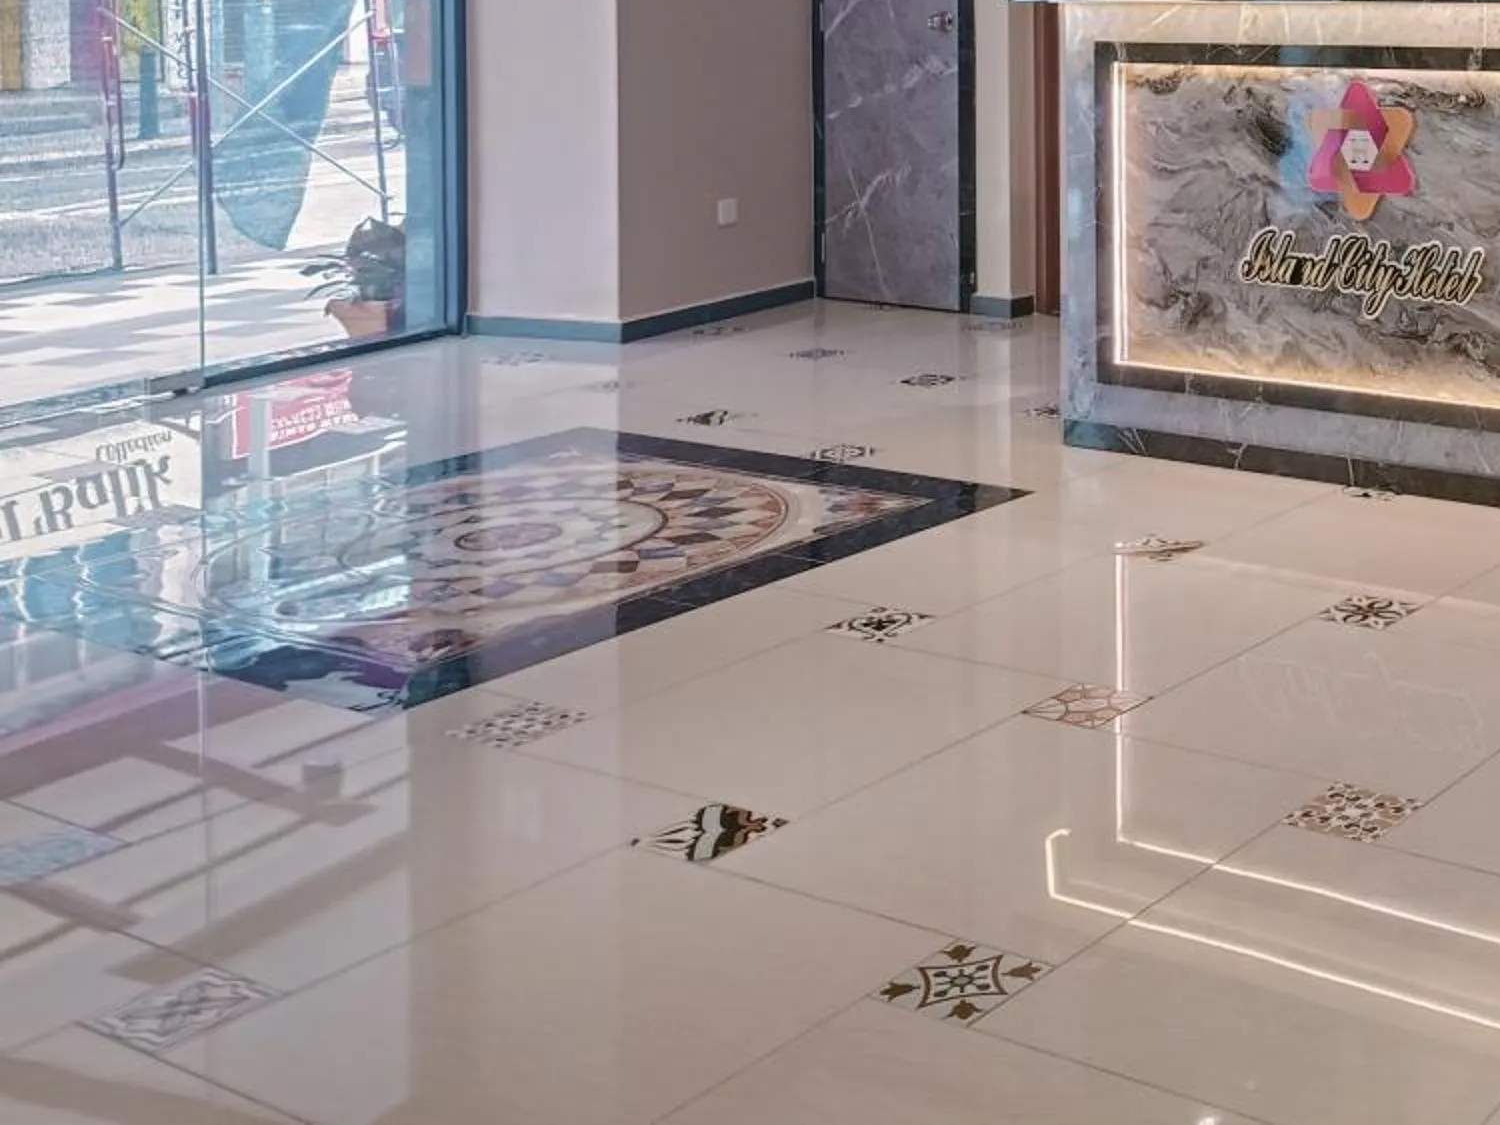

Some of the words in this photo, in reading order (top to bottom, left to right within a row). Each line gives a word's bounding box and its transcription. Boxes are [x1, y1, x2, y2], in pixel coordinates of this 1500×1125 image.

[1241, 227, 1341, 289] Island
[1336, 233, 1397, 318] City
[1393, 241, 1484, 304] Hotel
